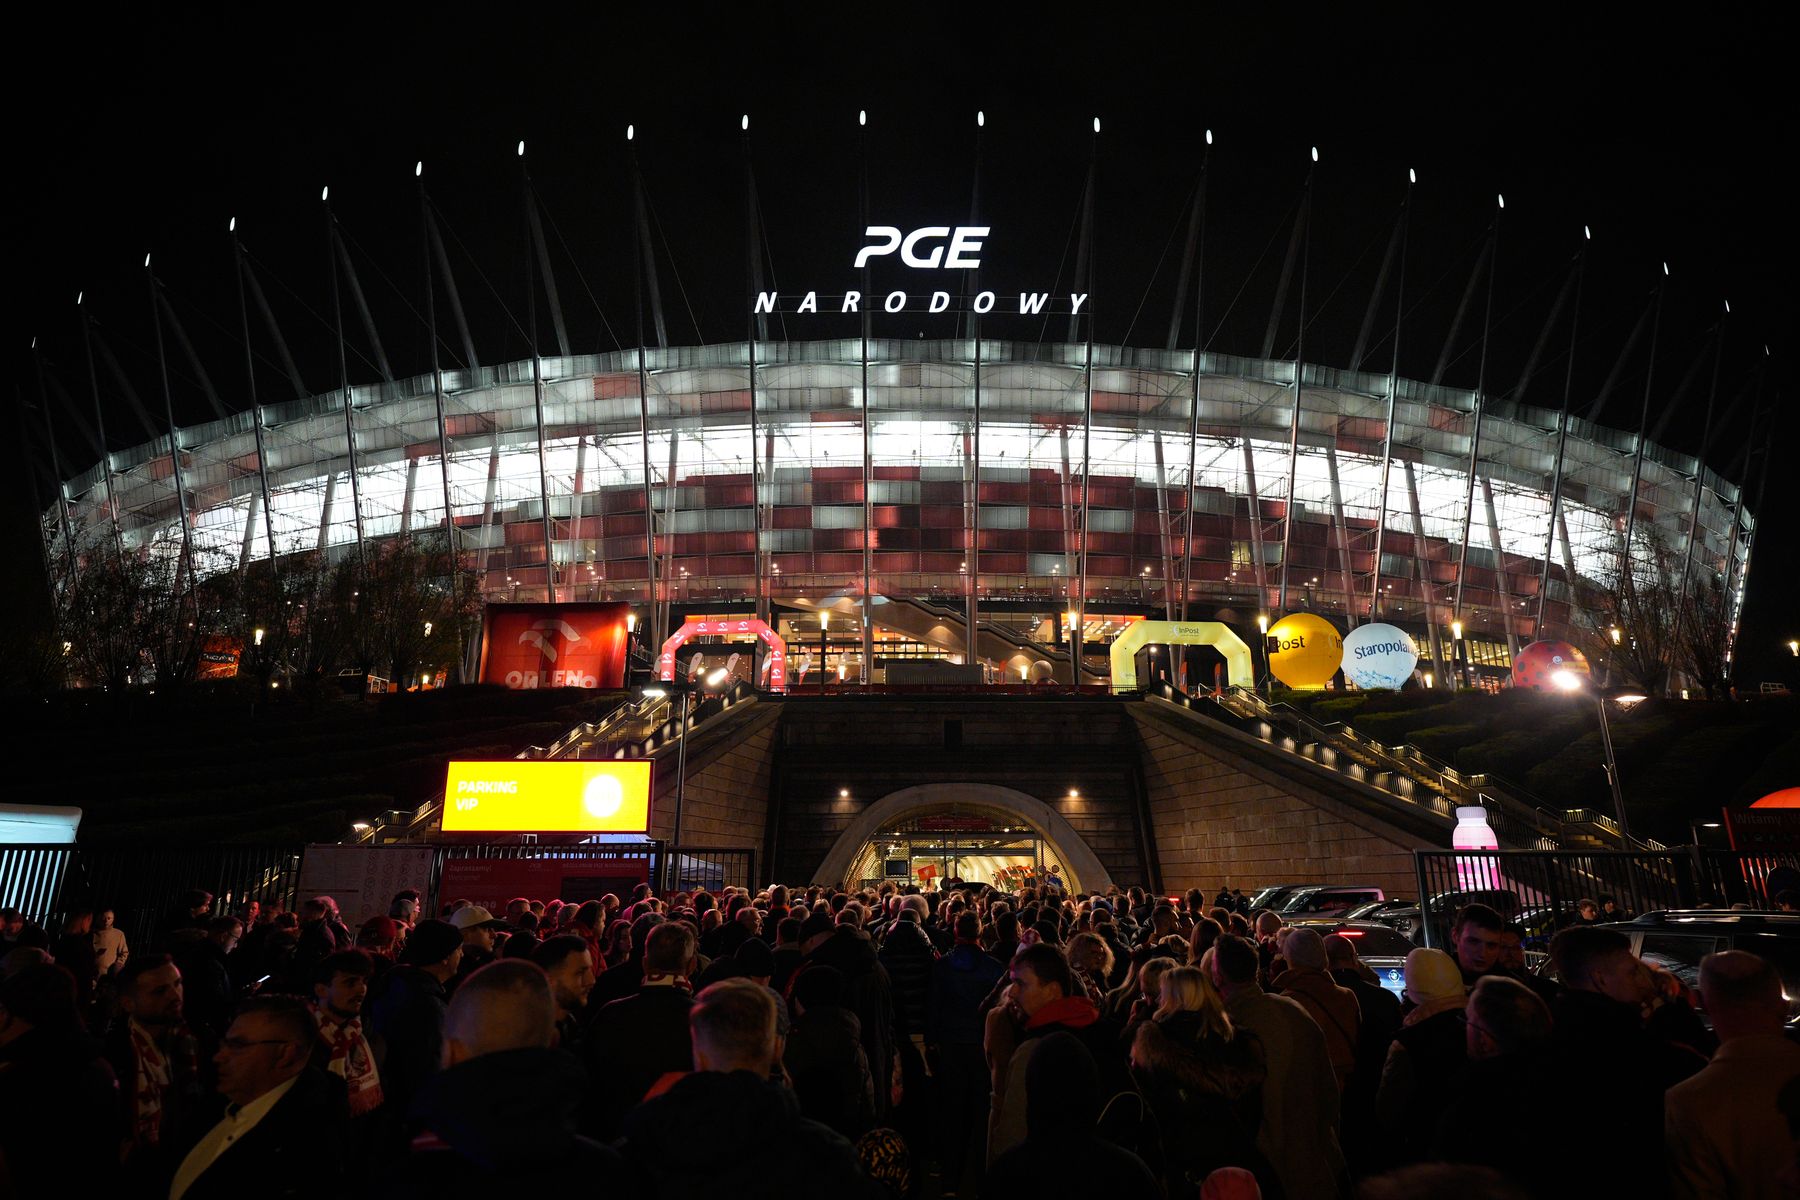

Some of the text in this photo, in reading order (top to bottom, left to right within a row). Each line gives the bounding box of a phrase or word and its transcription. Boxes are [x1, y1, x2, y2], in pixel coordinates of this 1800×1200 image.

[854, 226, 991, 269] PGE
[754, 290, 1088, 315] NARODOWY
[1354, 640, 1417, 660] Staropola
[457, 780, 518, 794] PARKING
[456, 798, 478, 811] VIP
